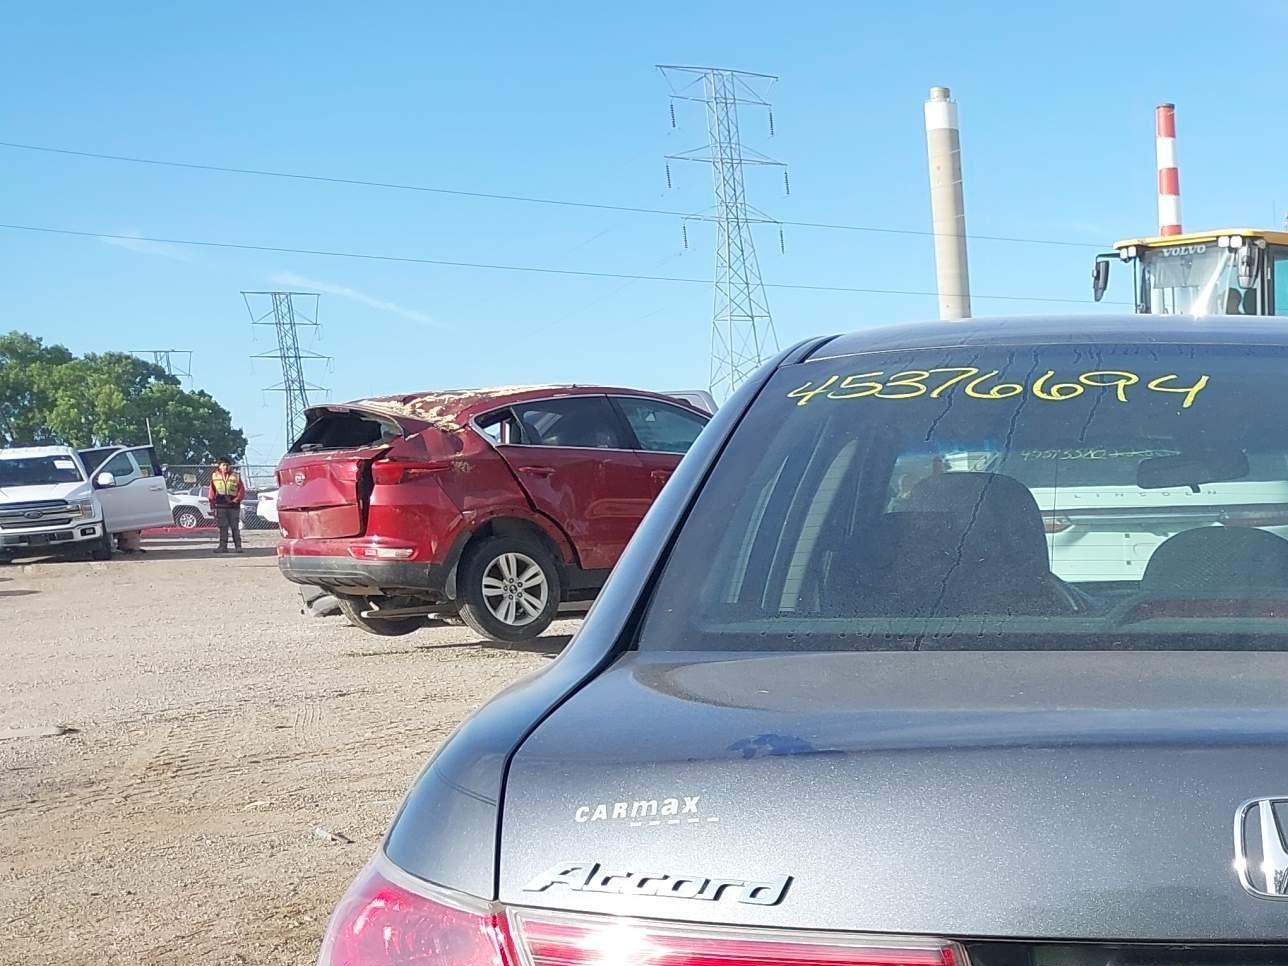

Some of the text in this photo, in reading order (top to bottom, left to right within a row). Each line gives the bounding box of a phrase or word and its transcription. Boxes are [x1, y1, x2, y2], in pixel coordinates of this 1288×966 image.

[1162, 245, 1206, 257] VOLVO
[787, 367, 1209, 408] 45376694
[522, 862, 795, 907] Accord
